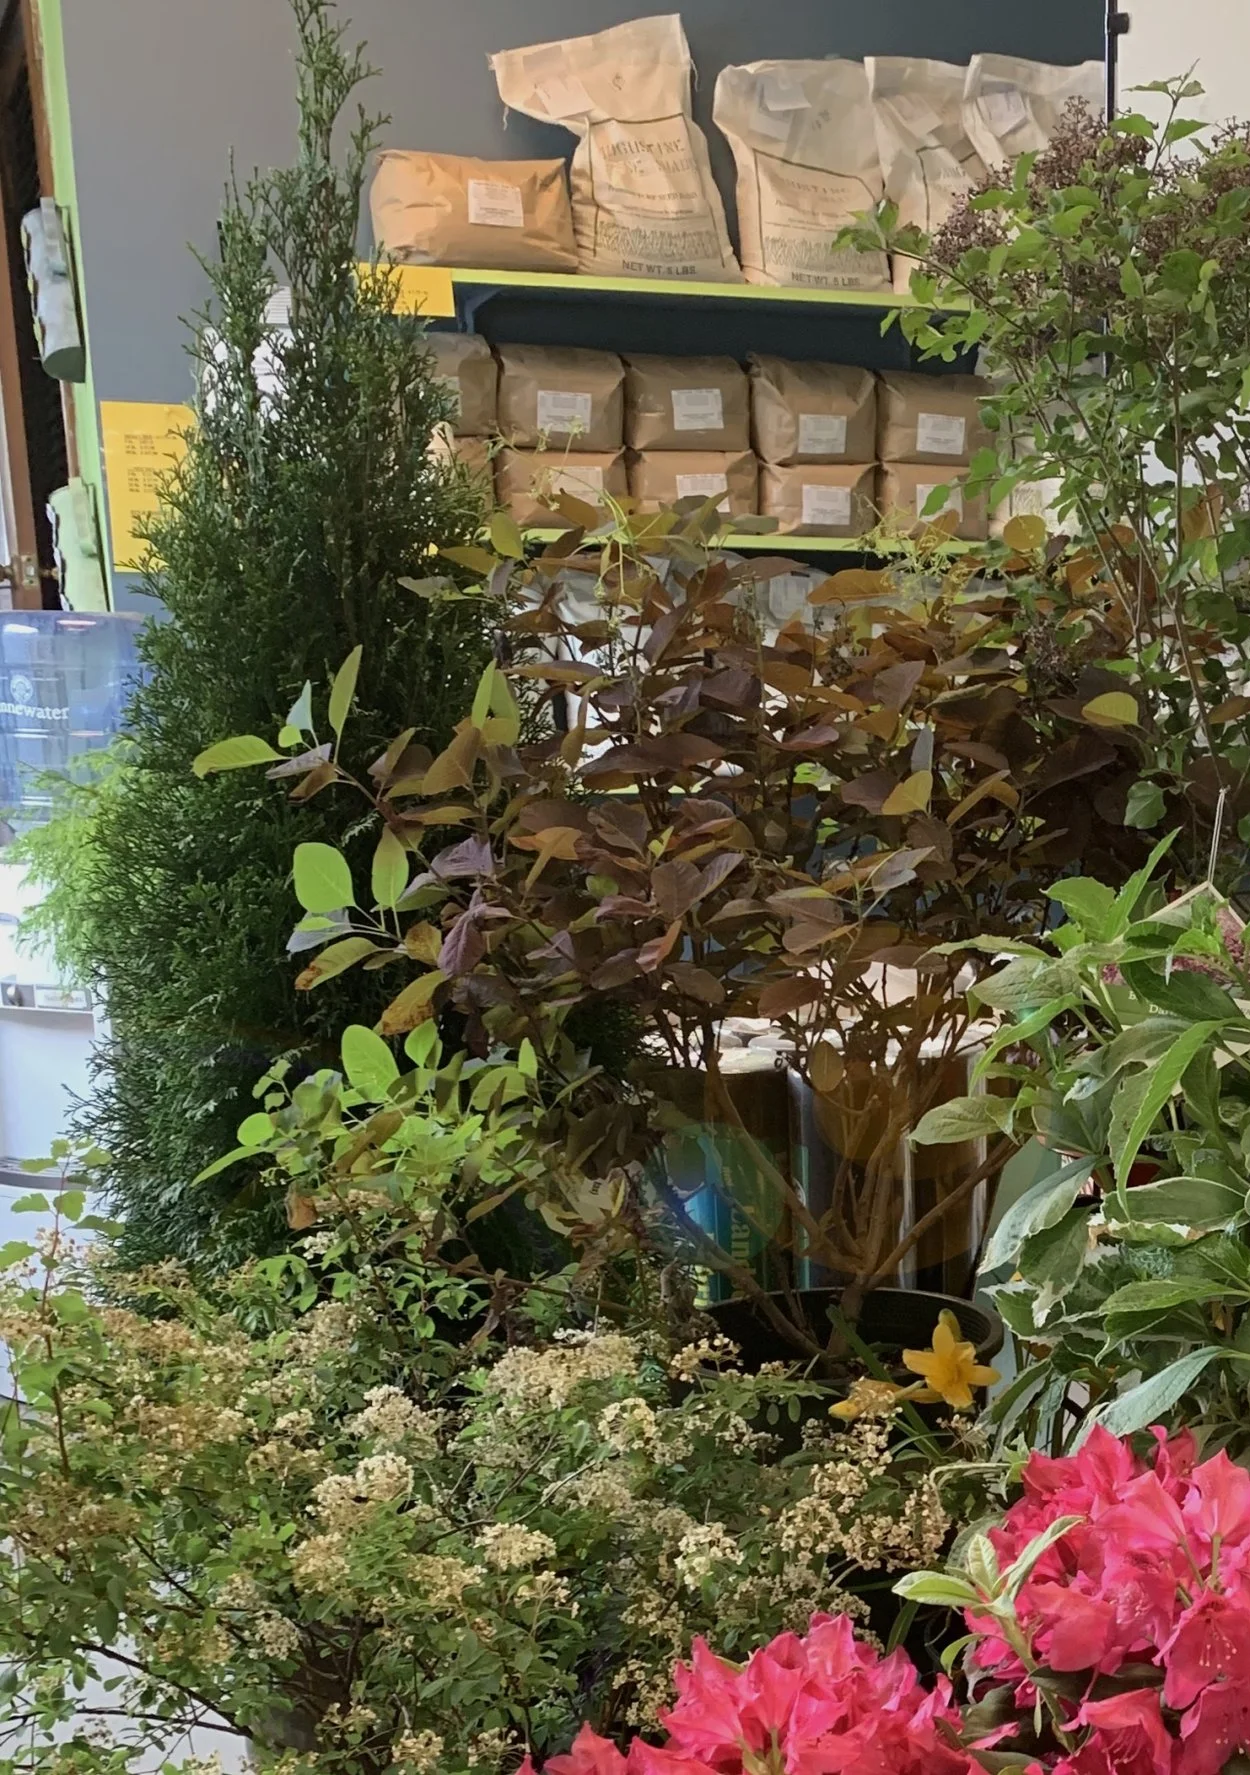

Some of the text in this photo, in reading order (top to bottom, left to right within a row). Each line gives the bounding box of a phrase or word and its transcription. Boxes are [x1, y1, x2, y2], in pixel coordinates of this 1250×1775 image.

[622, 259, 643, 271] NET
[791, 271, 811, 283] NET
[0, 702, 70, 720] nnewater
